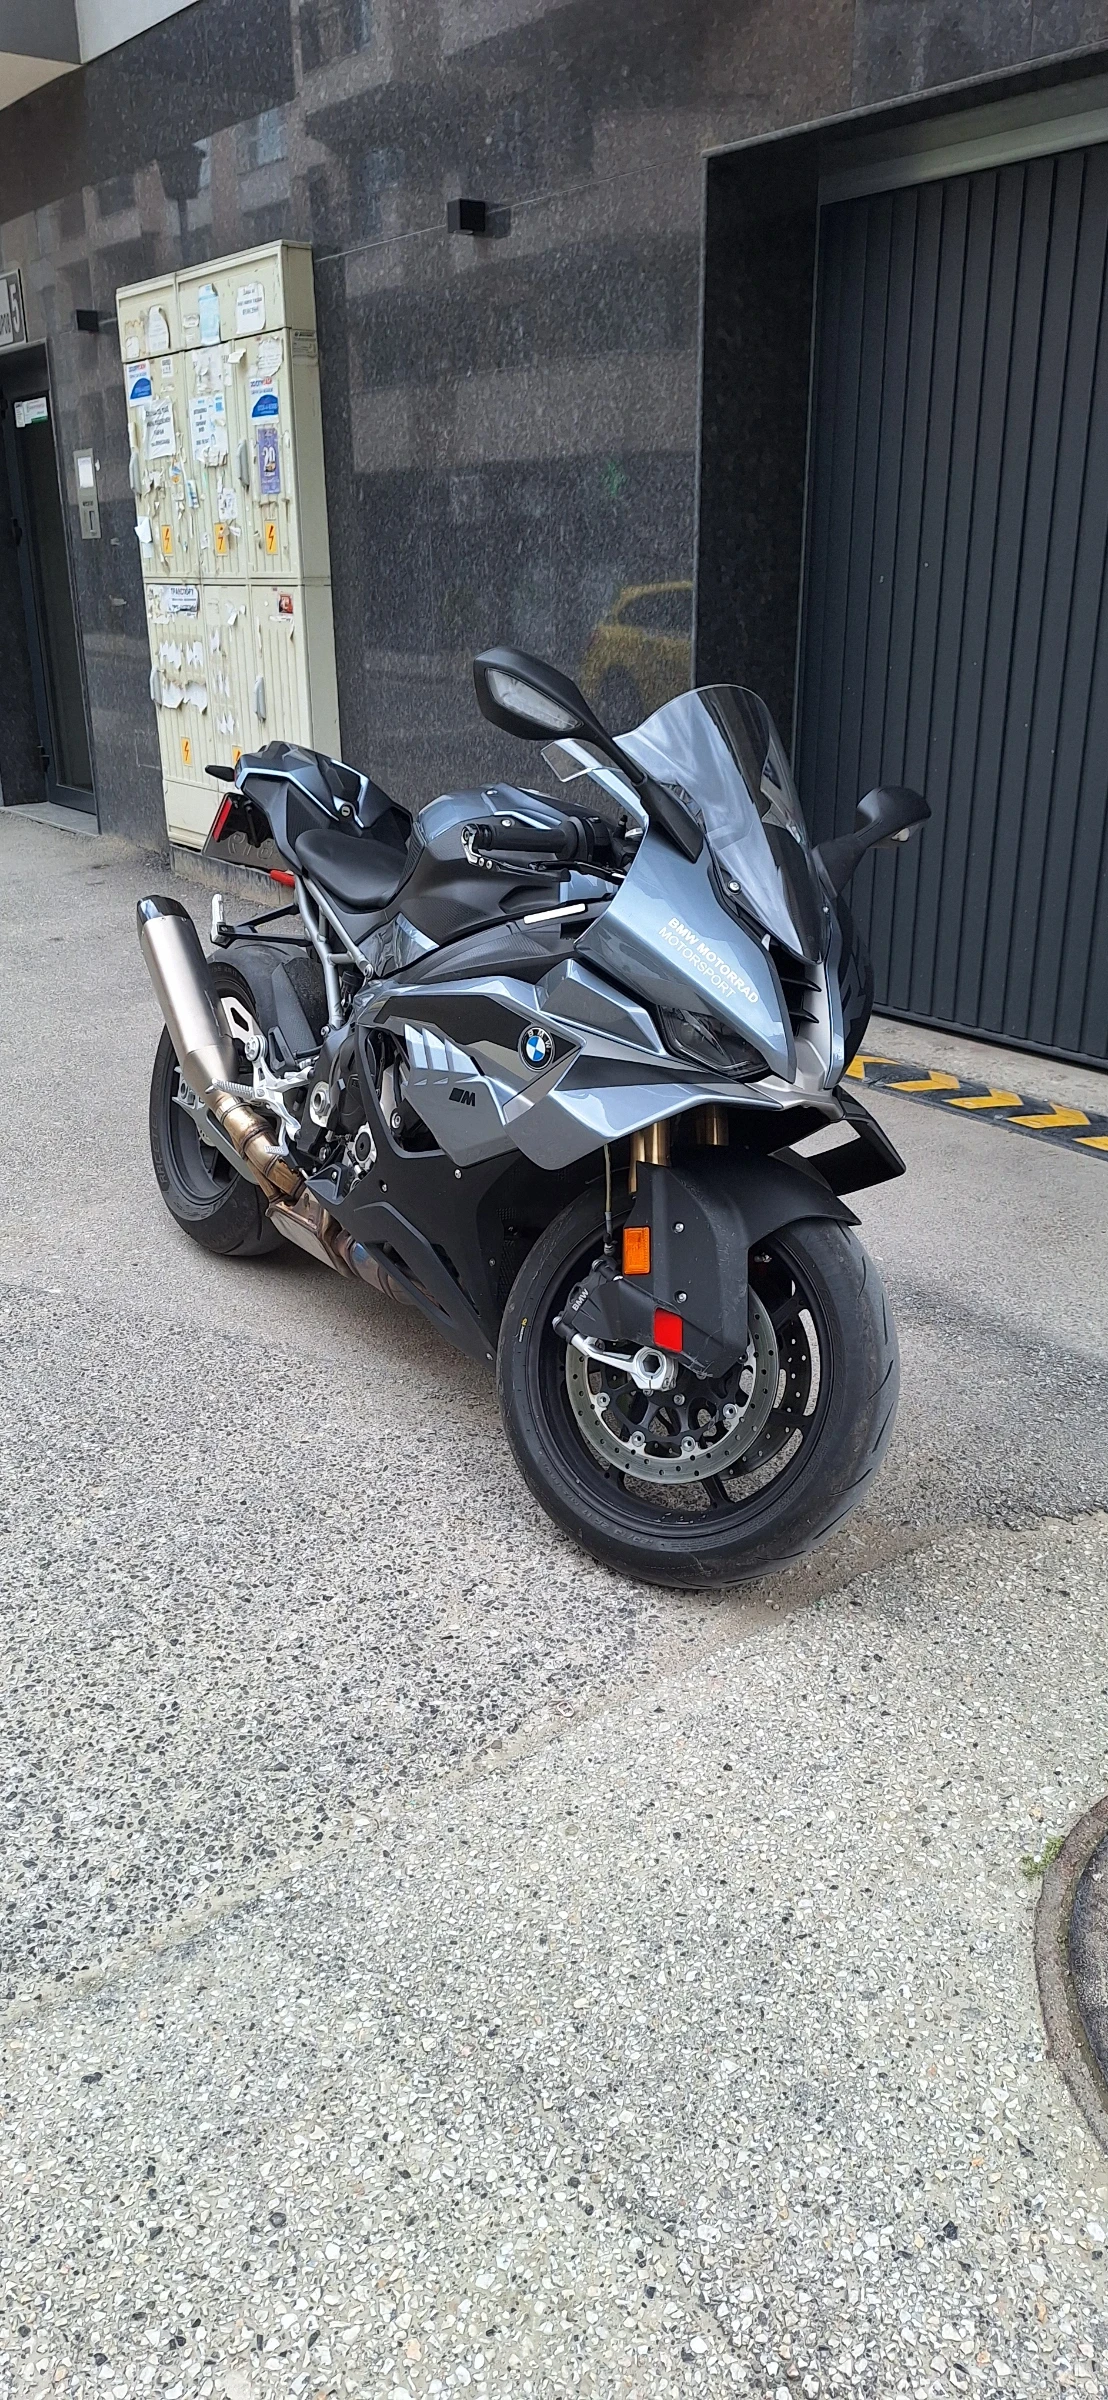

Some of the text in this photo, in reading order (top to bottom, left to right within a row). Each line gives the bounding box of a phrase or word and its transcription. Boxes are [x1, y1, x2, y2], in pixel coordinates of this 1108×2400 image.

[9, 283, 20, 333] 5
[658, 926, 736, 998] MOTORSPORT
[668, 917, 759, 1004] BMW MOTORRAD
[571, 1288, 589, 1312] BMW
